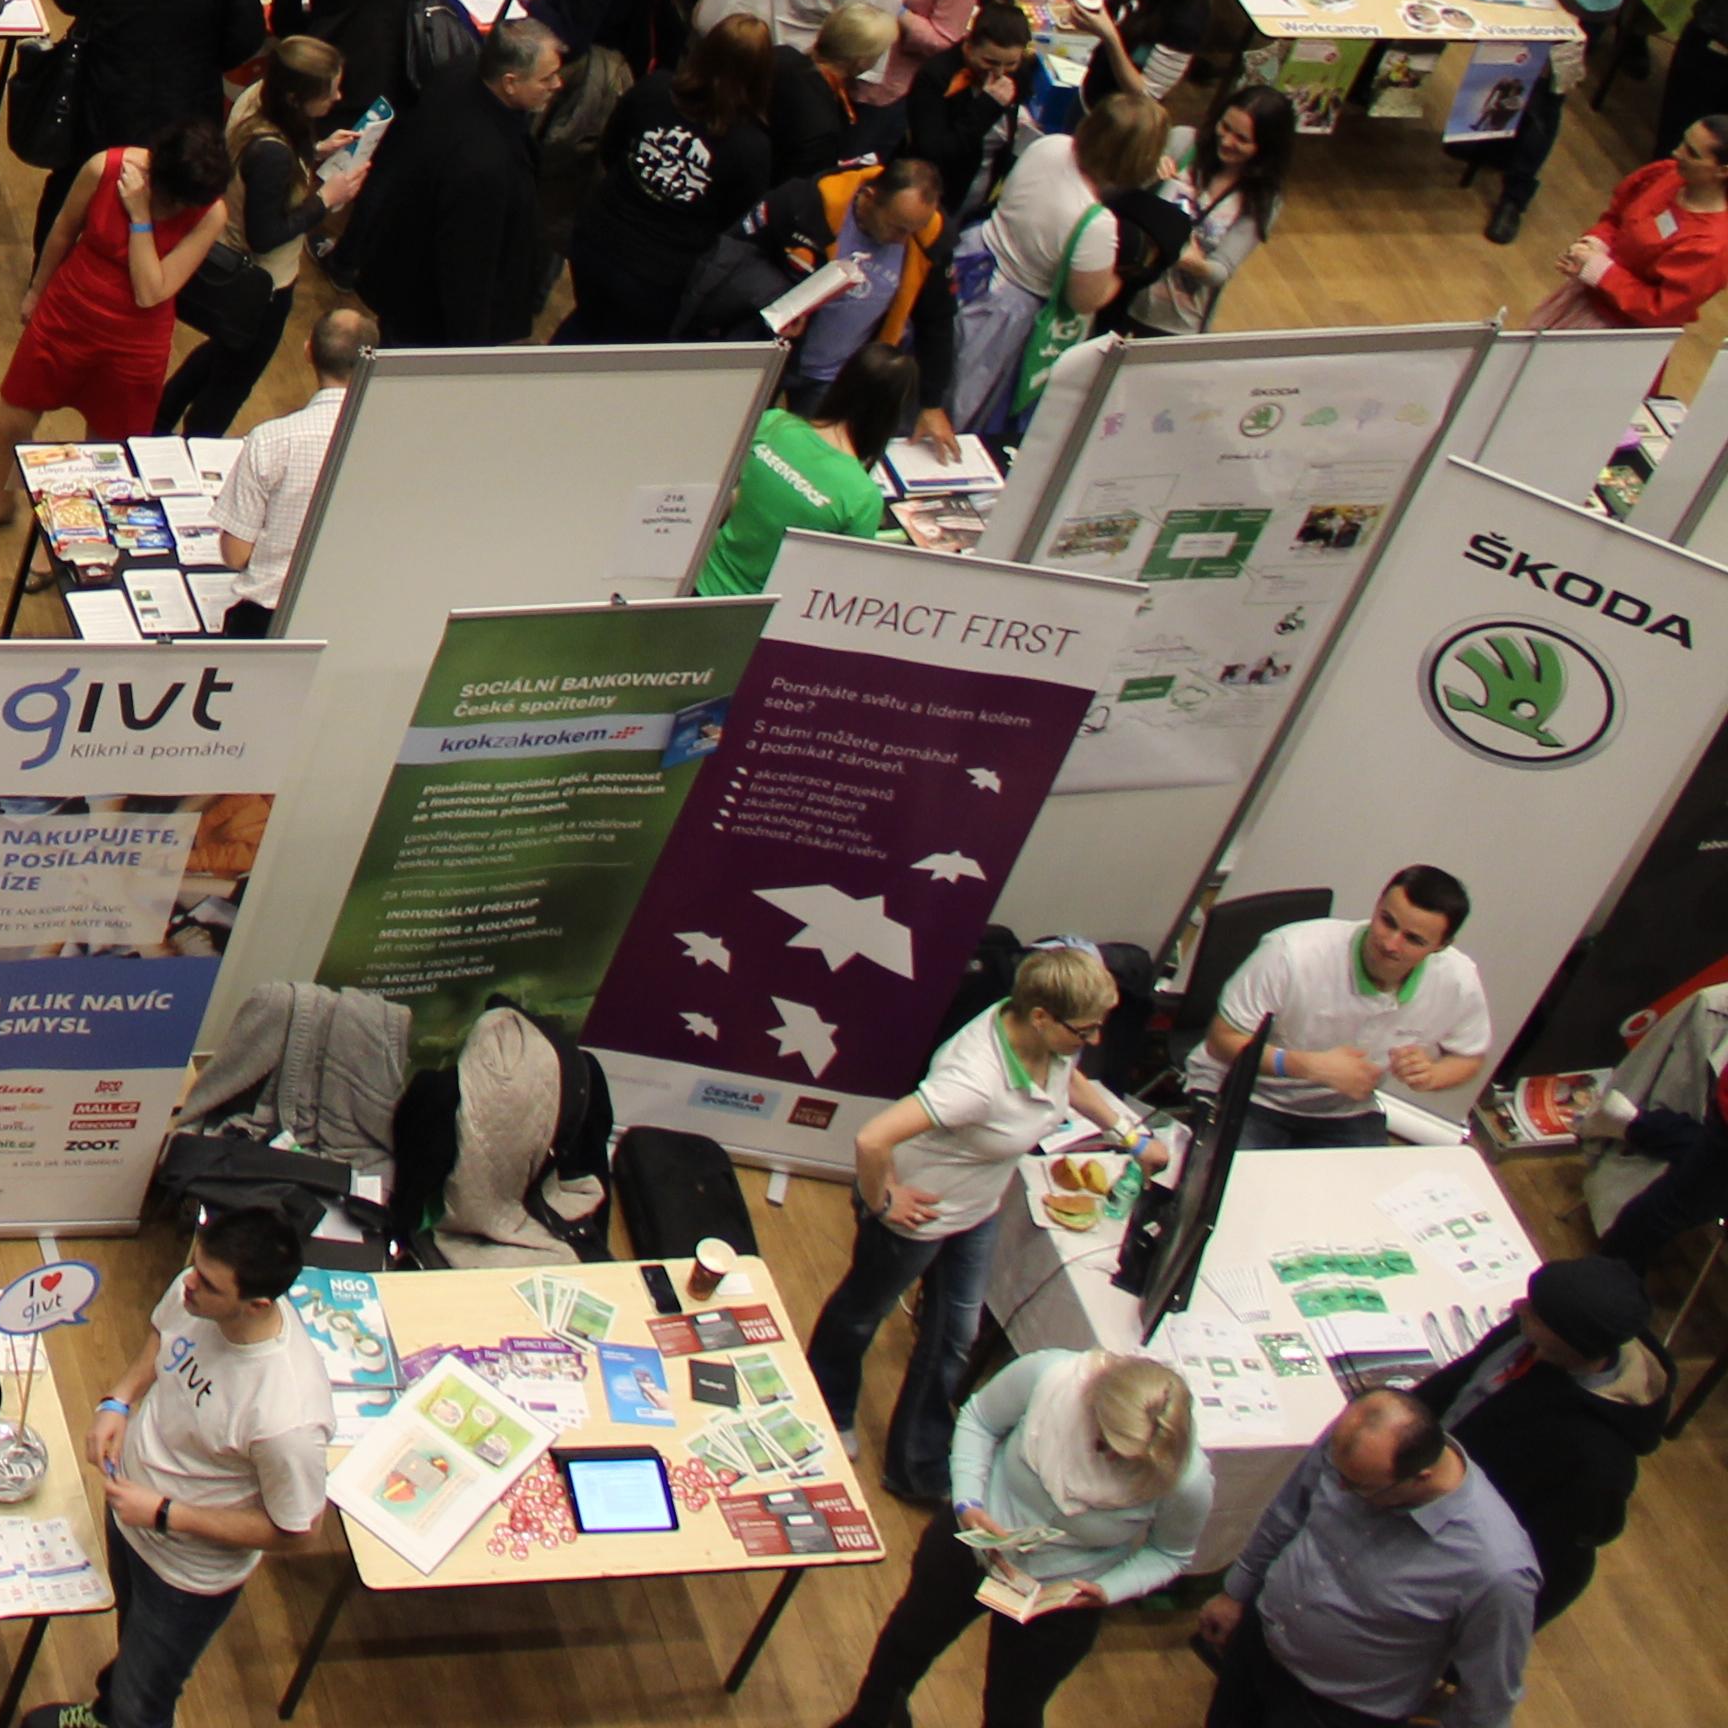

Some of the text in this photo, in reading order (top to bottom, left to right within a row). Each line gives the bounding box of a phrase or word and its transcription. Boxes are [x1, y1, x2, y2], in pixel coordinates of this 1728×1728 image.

[1280, 20, 1379, 38] Workcampy
[1463, 533, 1693, 649] ŠKODA
[802, 589, 1080, 657] IMPACT FIRST
[461, 666, 714, 698] SOCIÁLNÍ BANKOVNICTVÍ
[454, 693, 616, 719] České spořitelny
[764, 696, 816, 715] sebe?
[772, 675, 857, 702] Pomáháte
[861, 689, 908, 710] světu
[927, 702, 973, 720] lidem
[979, 708, 1031, 728] kolem
[2, 667, 234, 771] givt
[70, 740, 246, 762] Klikni a pomáhej
[440, 727, 608, 753] krokzakrokem
[753, 720, 958, 765] S námi můžete pomáhat
[2, 825, 181, 849] NAKUPUJETE,
[0, 846, 142, 869] POSÍLÁME
[8, 993, 74, 1015] KLIK
[78, 988, 174, 1014] NAVÍC
[329, 1278, 369, 1294] NGO
[21, 1277, 64, 1327] I givt
[164, 1336, 213, 1408] givt
